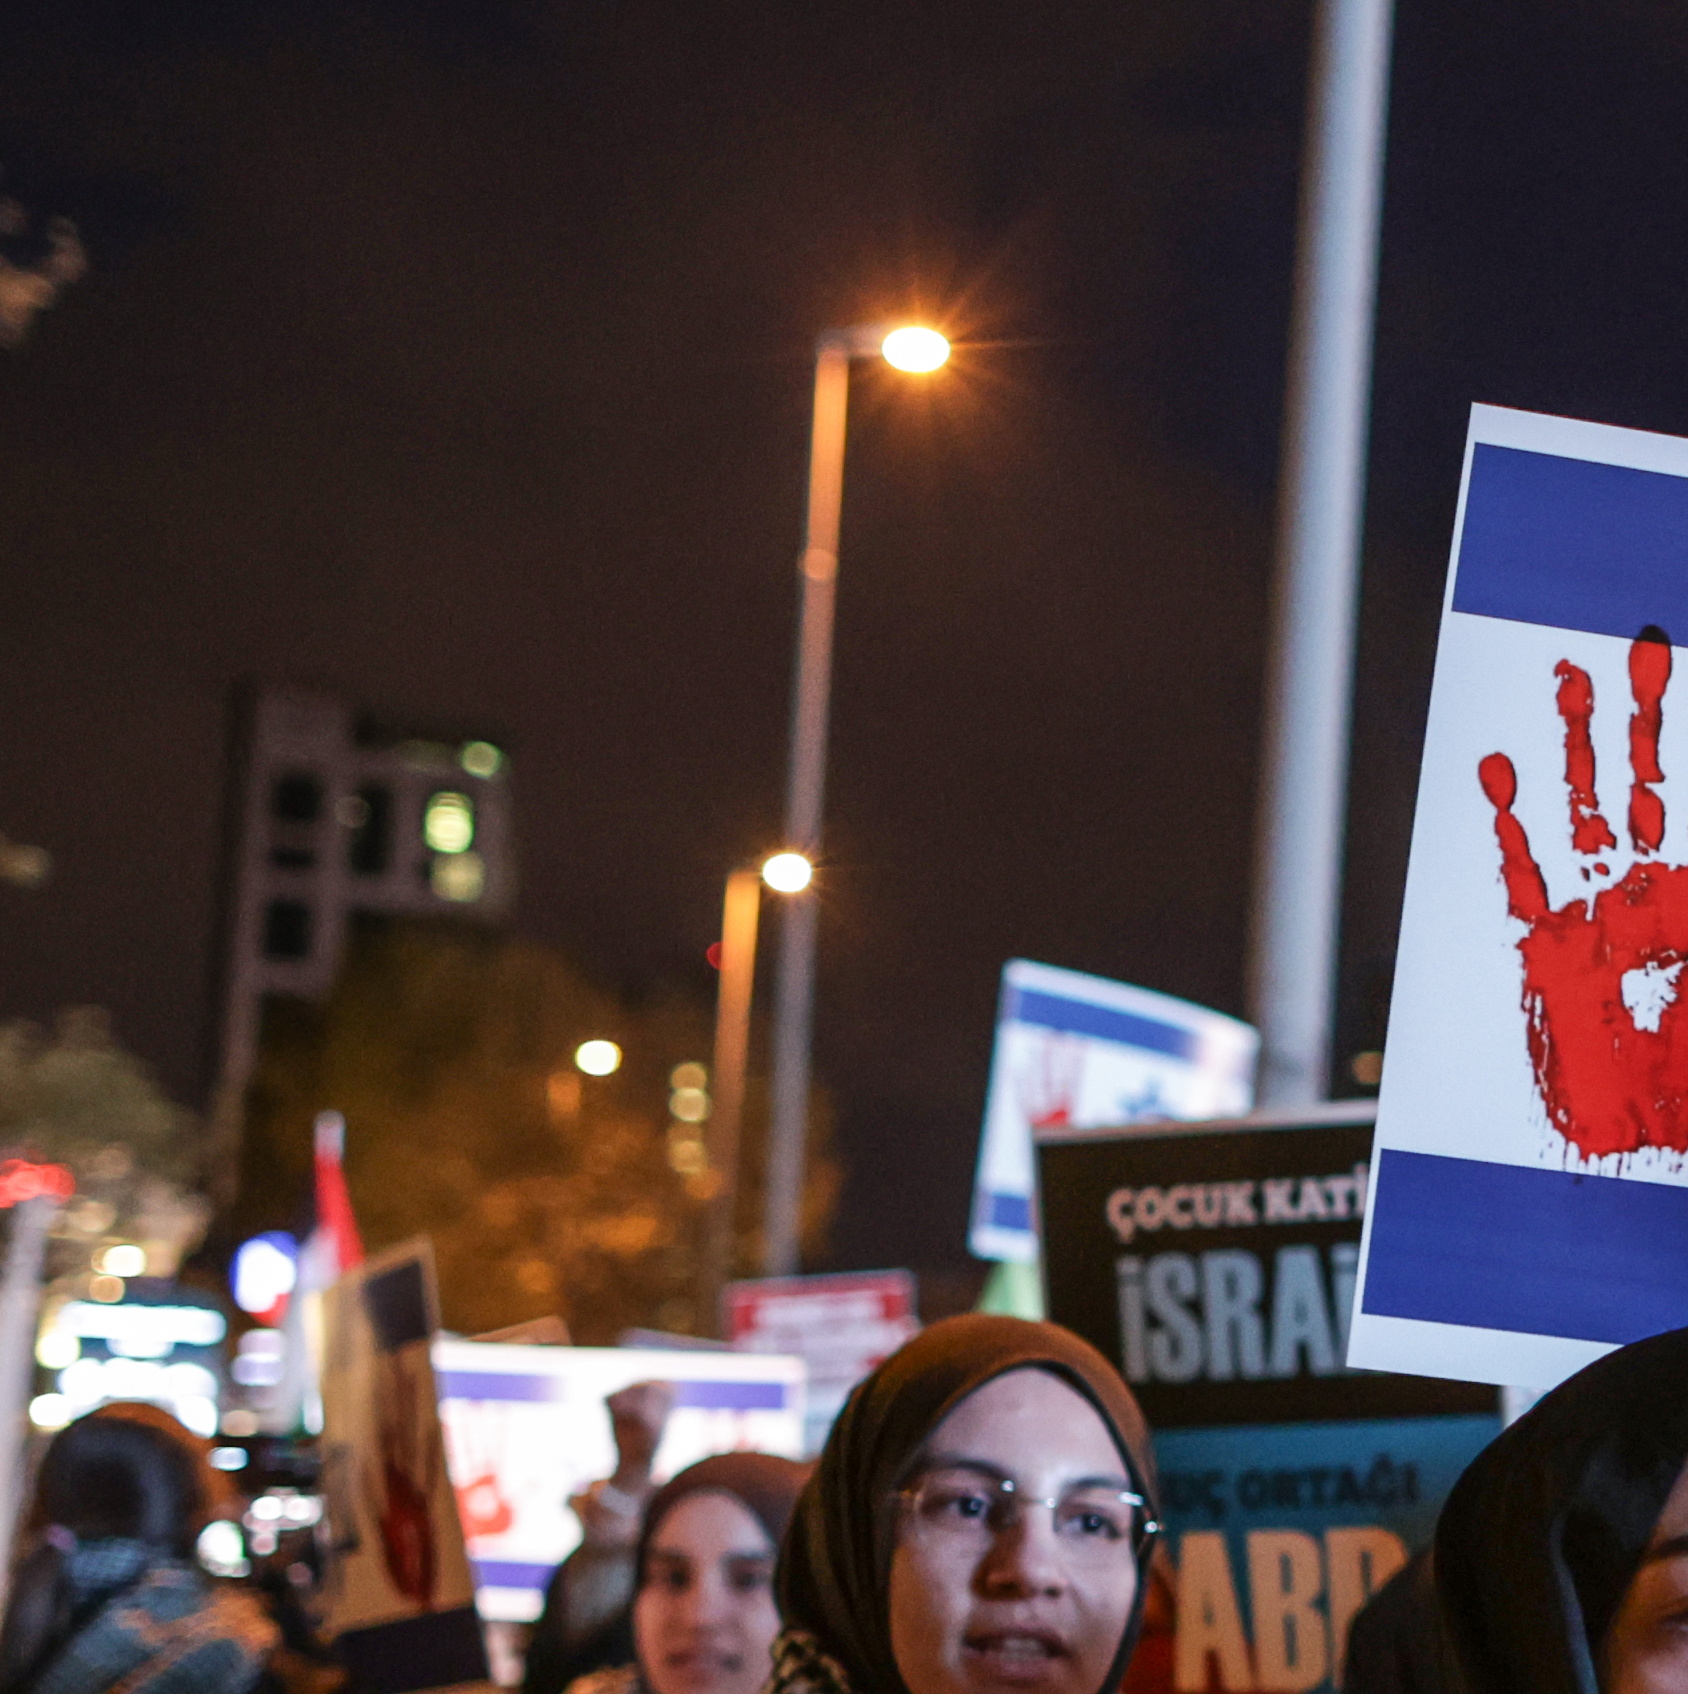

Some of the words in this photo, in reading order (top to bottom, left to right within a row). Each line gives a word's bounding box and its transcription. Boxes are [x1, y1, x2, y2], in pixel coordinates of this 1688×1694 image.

[1106, 1181, 1258, 1243] ÇOCUK
[1261, 1163, 1370, 1225] KATİ
[1116, 1243, 1359, 1383] İSRAİ
[1159, 1467, 1225, 1520] UÇ
